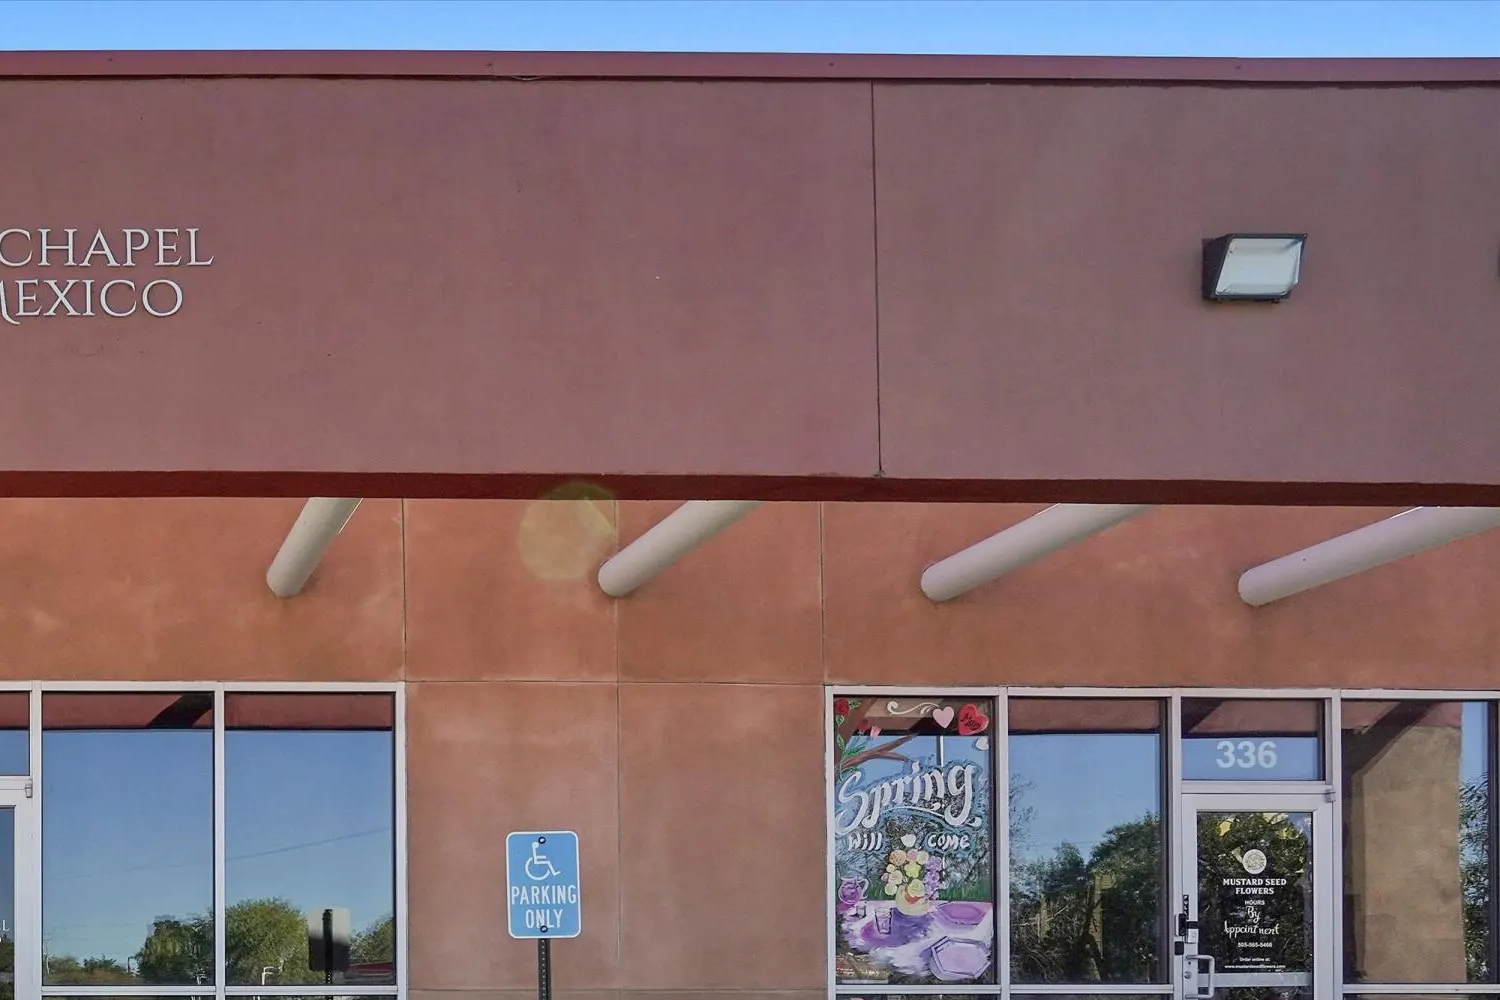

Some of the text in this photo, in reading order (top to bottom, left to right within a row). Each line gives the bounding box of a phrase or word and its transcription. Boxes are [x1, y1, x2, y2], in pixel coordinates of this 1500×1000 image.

[1216, 740, 1277, 768] 336
[835, 760, 982, 836] Spring
[1222, 878, 1287, 886] MUSTARD SEED
[1235, 887, 1275, 895] FLOWERS
[511, 885, 577, 905] PARKING
[525, 908, 563, 929] ONLY
[1245, 905, 1260, 924] By
